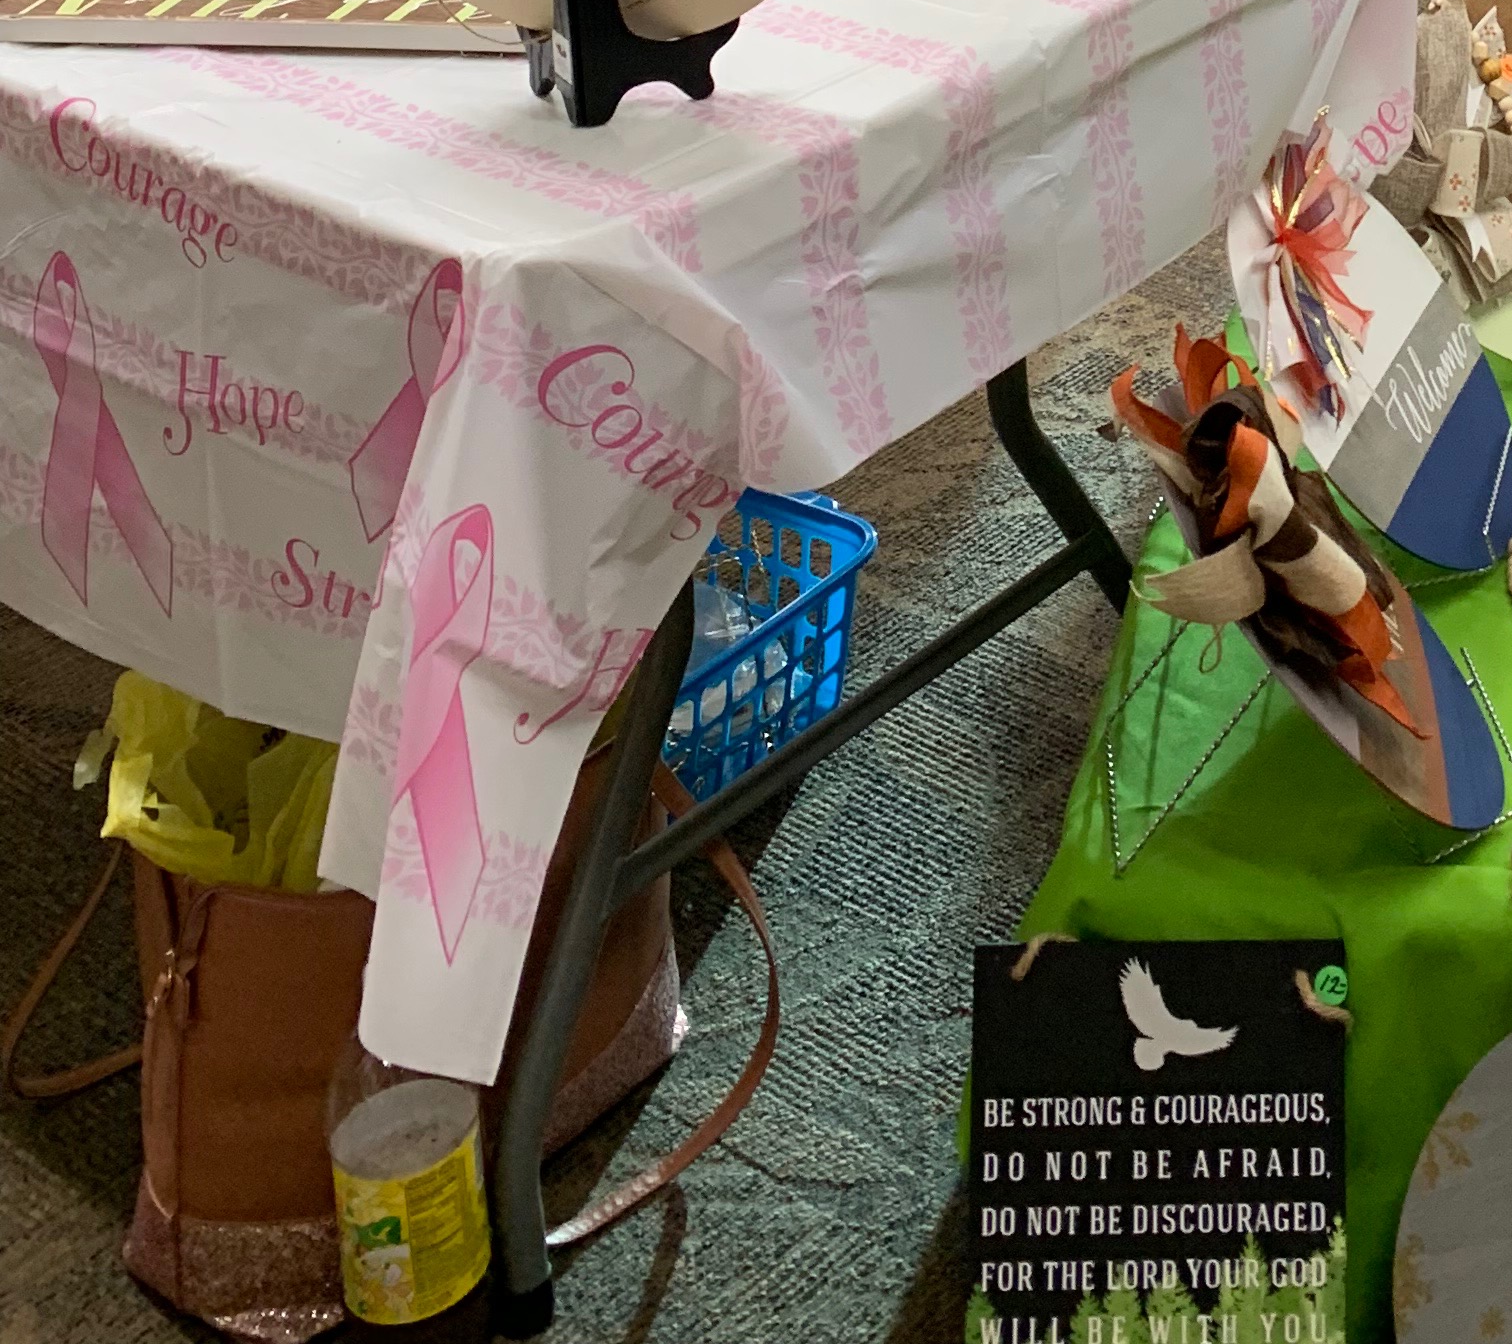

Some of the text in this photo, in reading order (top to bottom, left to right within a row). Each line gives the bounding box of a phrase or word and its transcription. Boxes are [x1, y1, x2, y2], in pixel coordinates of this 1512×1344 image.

[49, 96, 240, 268] Courage
[163, 349, 306, 457] Hope
[983, 1092, 1332, 1128] BE STRONG & COURAGEOUS,
[982, 1147, 1332, 1182] DO NOT BE AFRAID,
[980, 1201, 1332, 1237] DO NOT BE DISCOURAGED,
[980, 1257, 1328, 1292] FOR THE LORD YOUR GOD
[980, 1313, 1328, 1344] WILL BE WITH YOU
